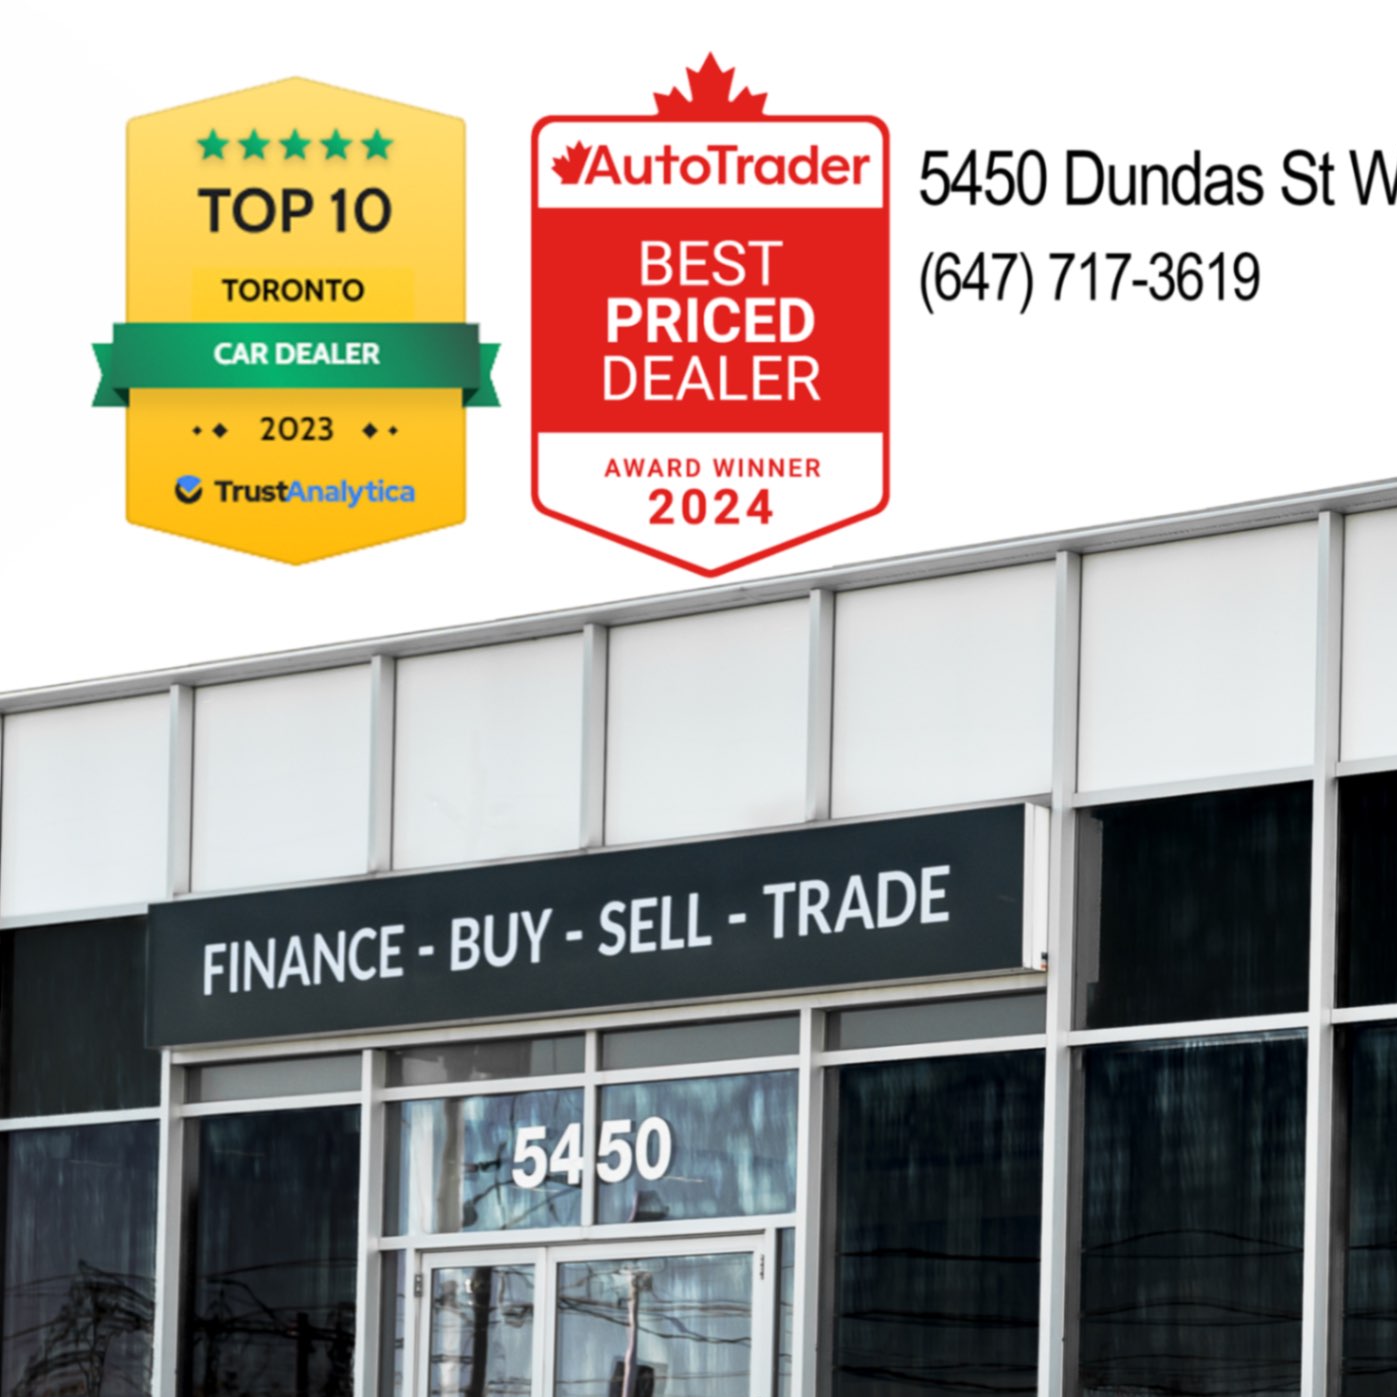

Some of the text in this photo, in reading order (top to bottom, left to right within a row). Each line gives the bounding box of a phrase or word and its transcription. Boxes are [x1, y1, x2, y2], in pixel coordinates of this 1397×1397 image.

[203, 924, 405, 996] FINANCE
[450, 908, 553, 972] BUY
[598, 892, 712, 956] SELL
[763, 864, 950, 939] TRADE
[512, 1116, 672, 1189] 5450
